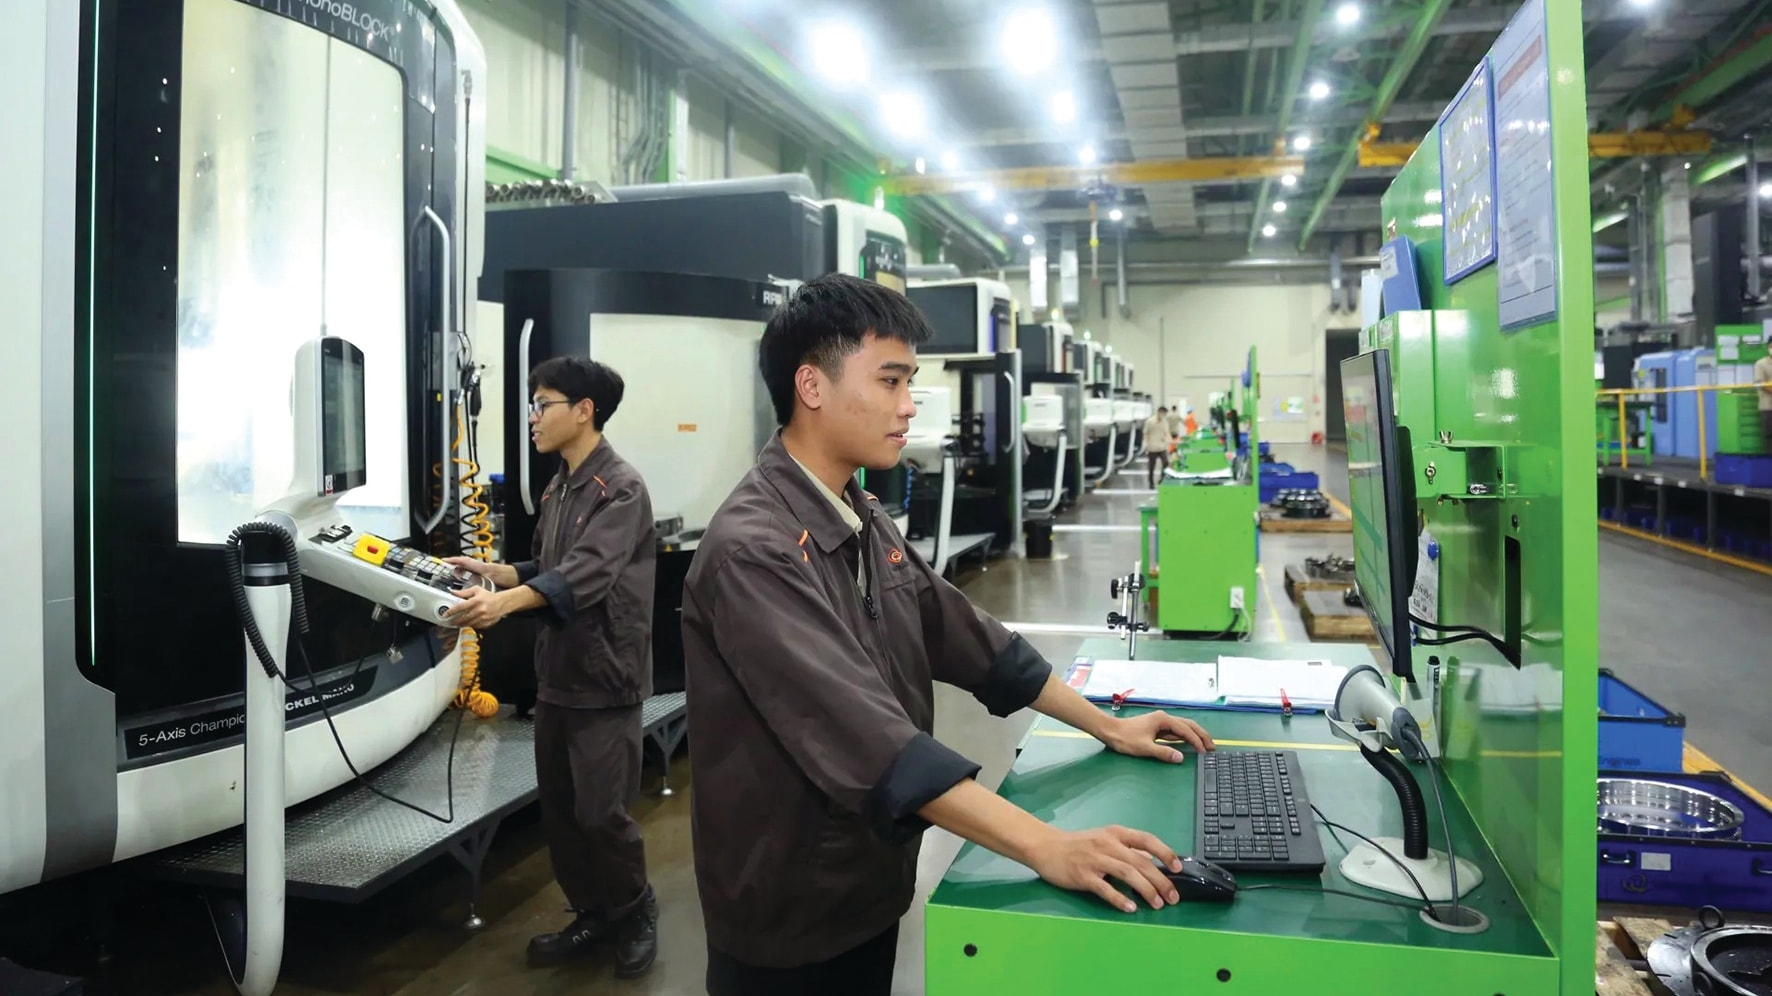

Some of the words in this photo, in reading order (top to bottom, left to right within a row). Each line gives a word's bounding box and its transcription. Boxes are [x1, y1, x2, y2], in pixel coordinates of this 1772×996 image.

[138, 727, 187, 747] 5-Axis
[190, 713, 245, 736] Champio
[285, 695, 319, 711] CKEL
